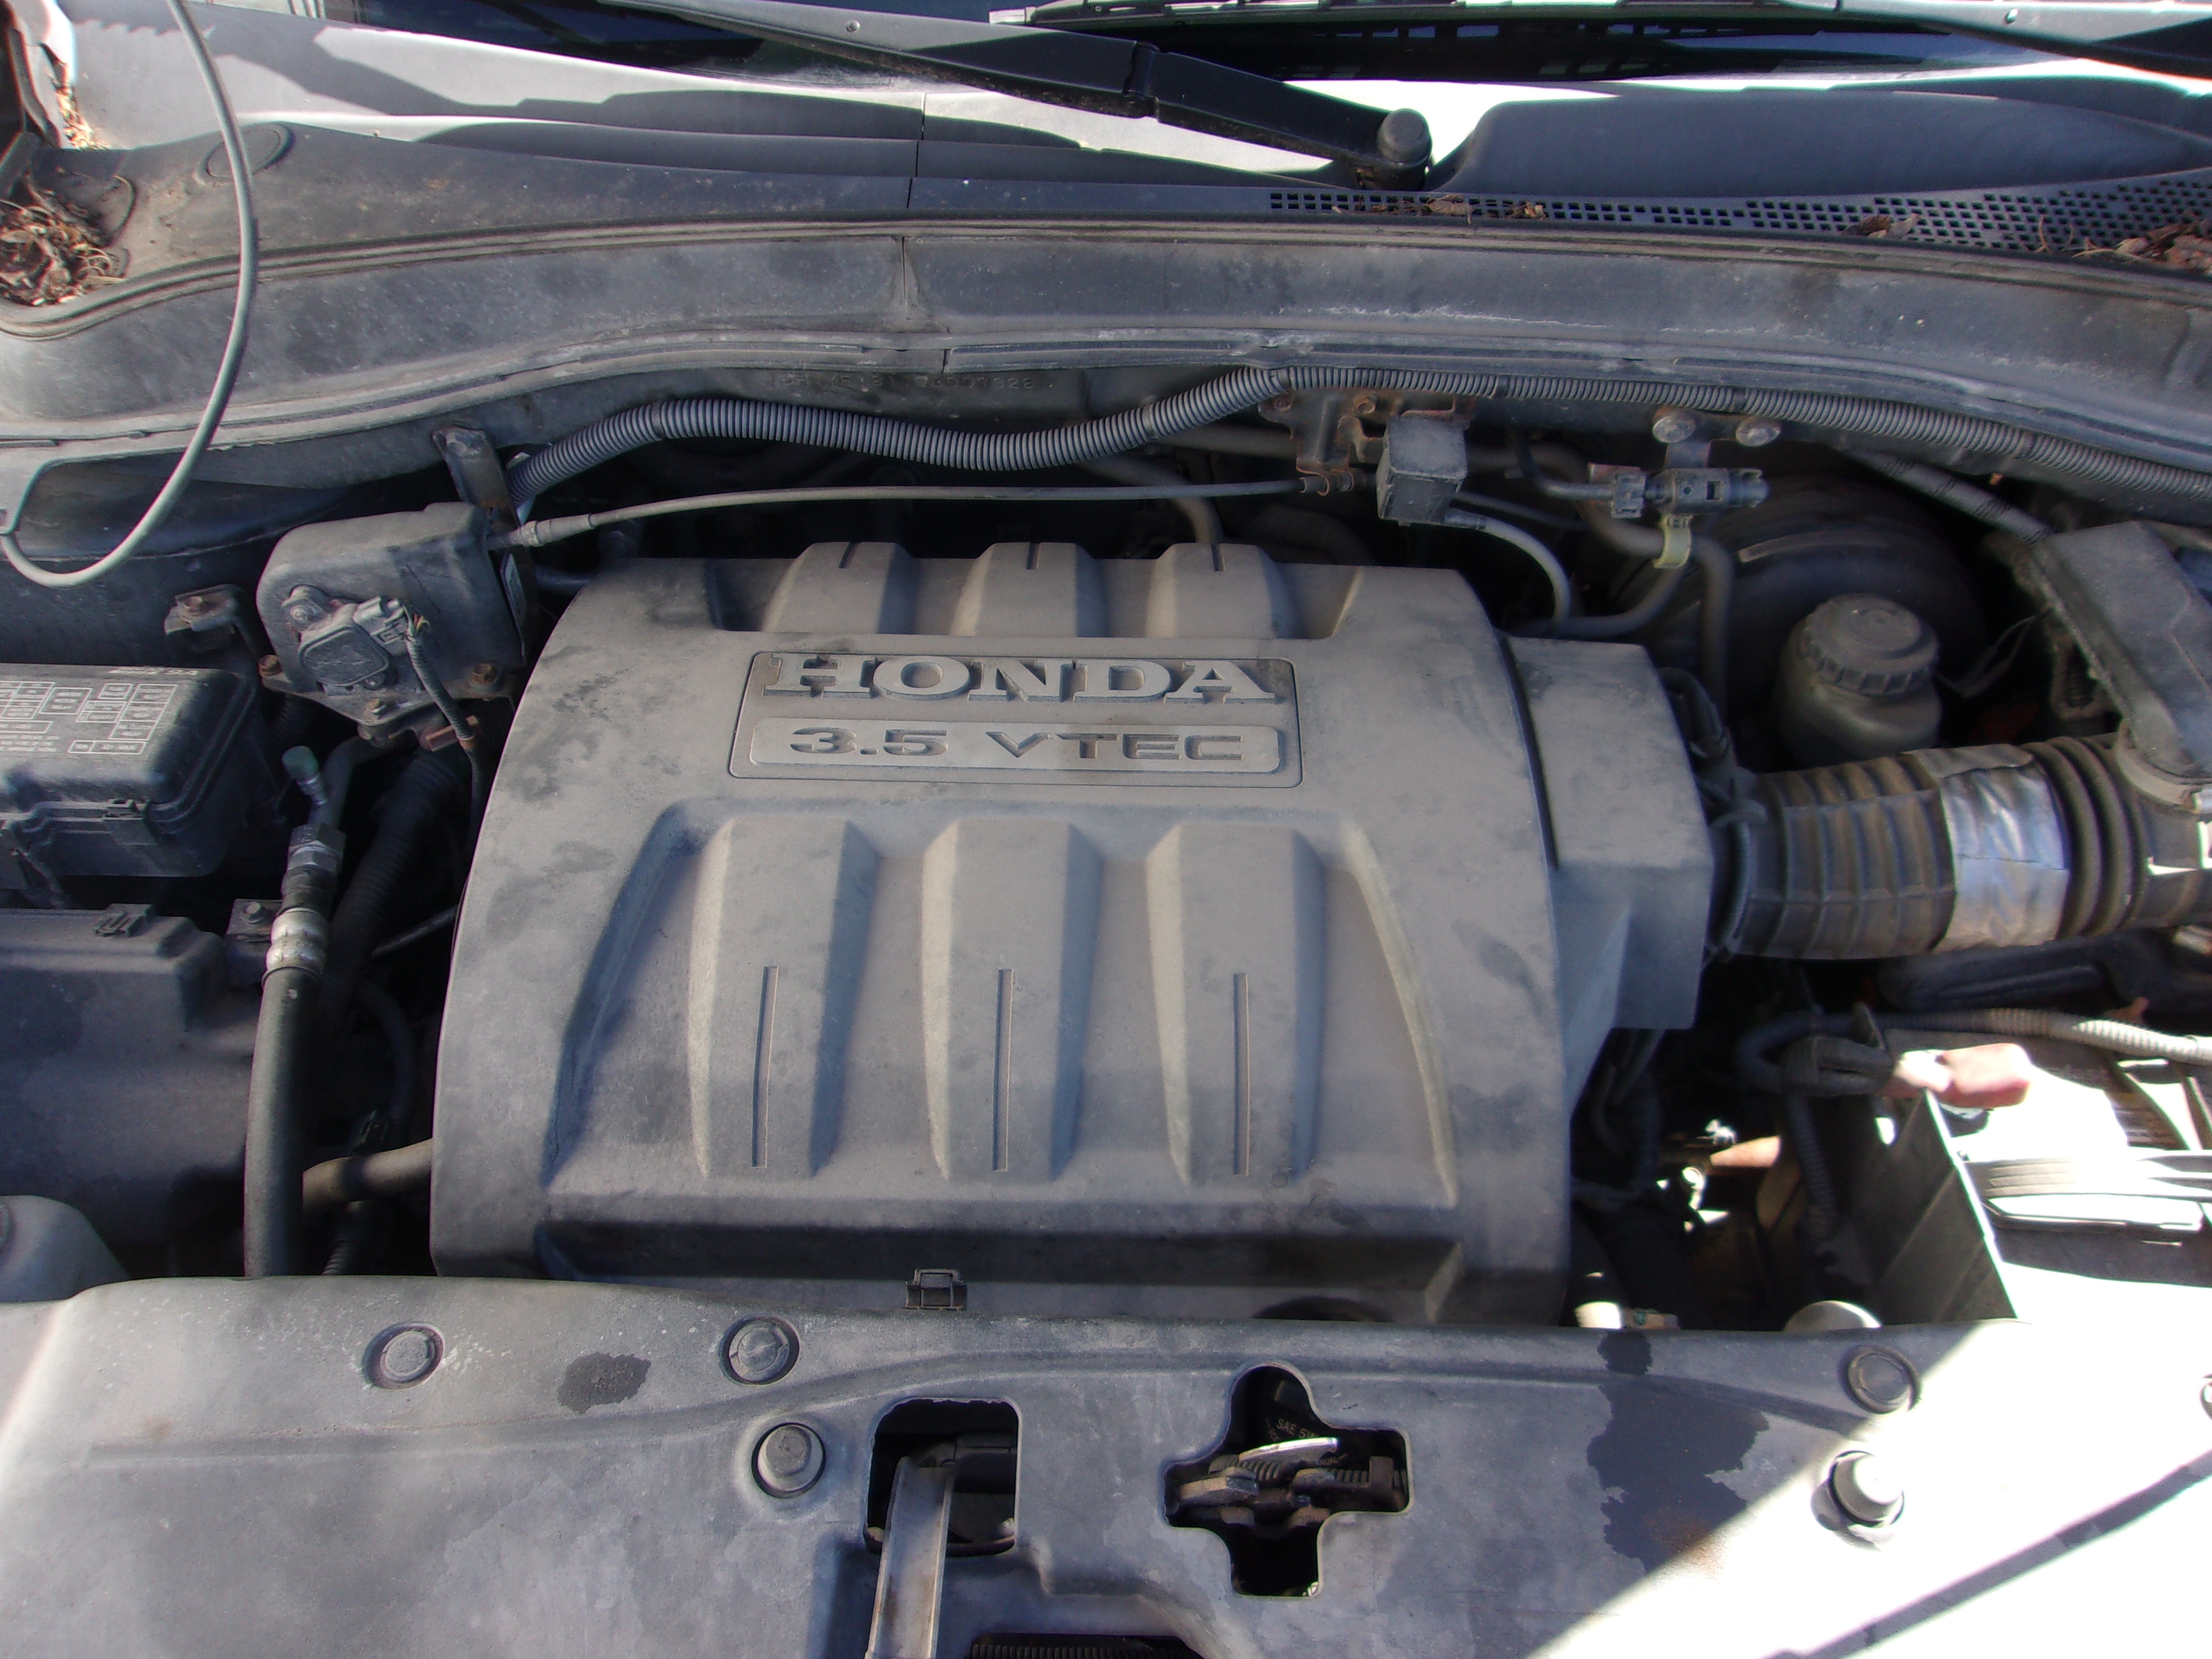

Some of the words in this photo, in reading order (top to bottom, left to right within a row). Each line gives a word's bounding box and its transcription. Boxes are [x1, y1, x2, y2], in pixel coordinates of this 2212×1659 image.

[763, 653, 1277, 703] HONDA
[790, 727, 949, 756] 3.5
[985, 731, 1245, 760] VTEC
[1276, 1418, 1297, 1435] SAE
